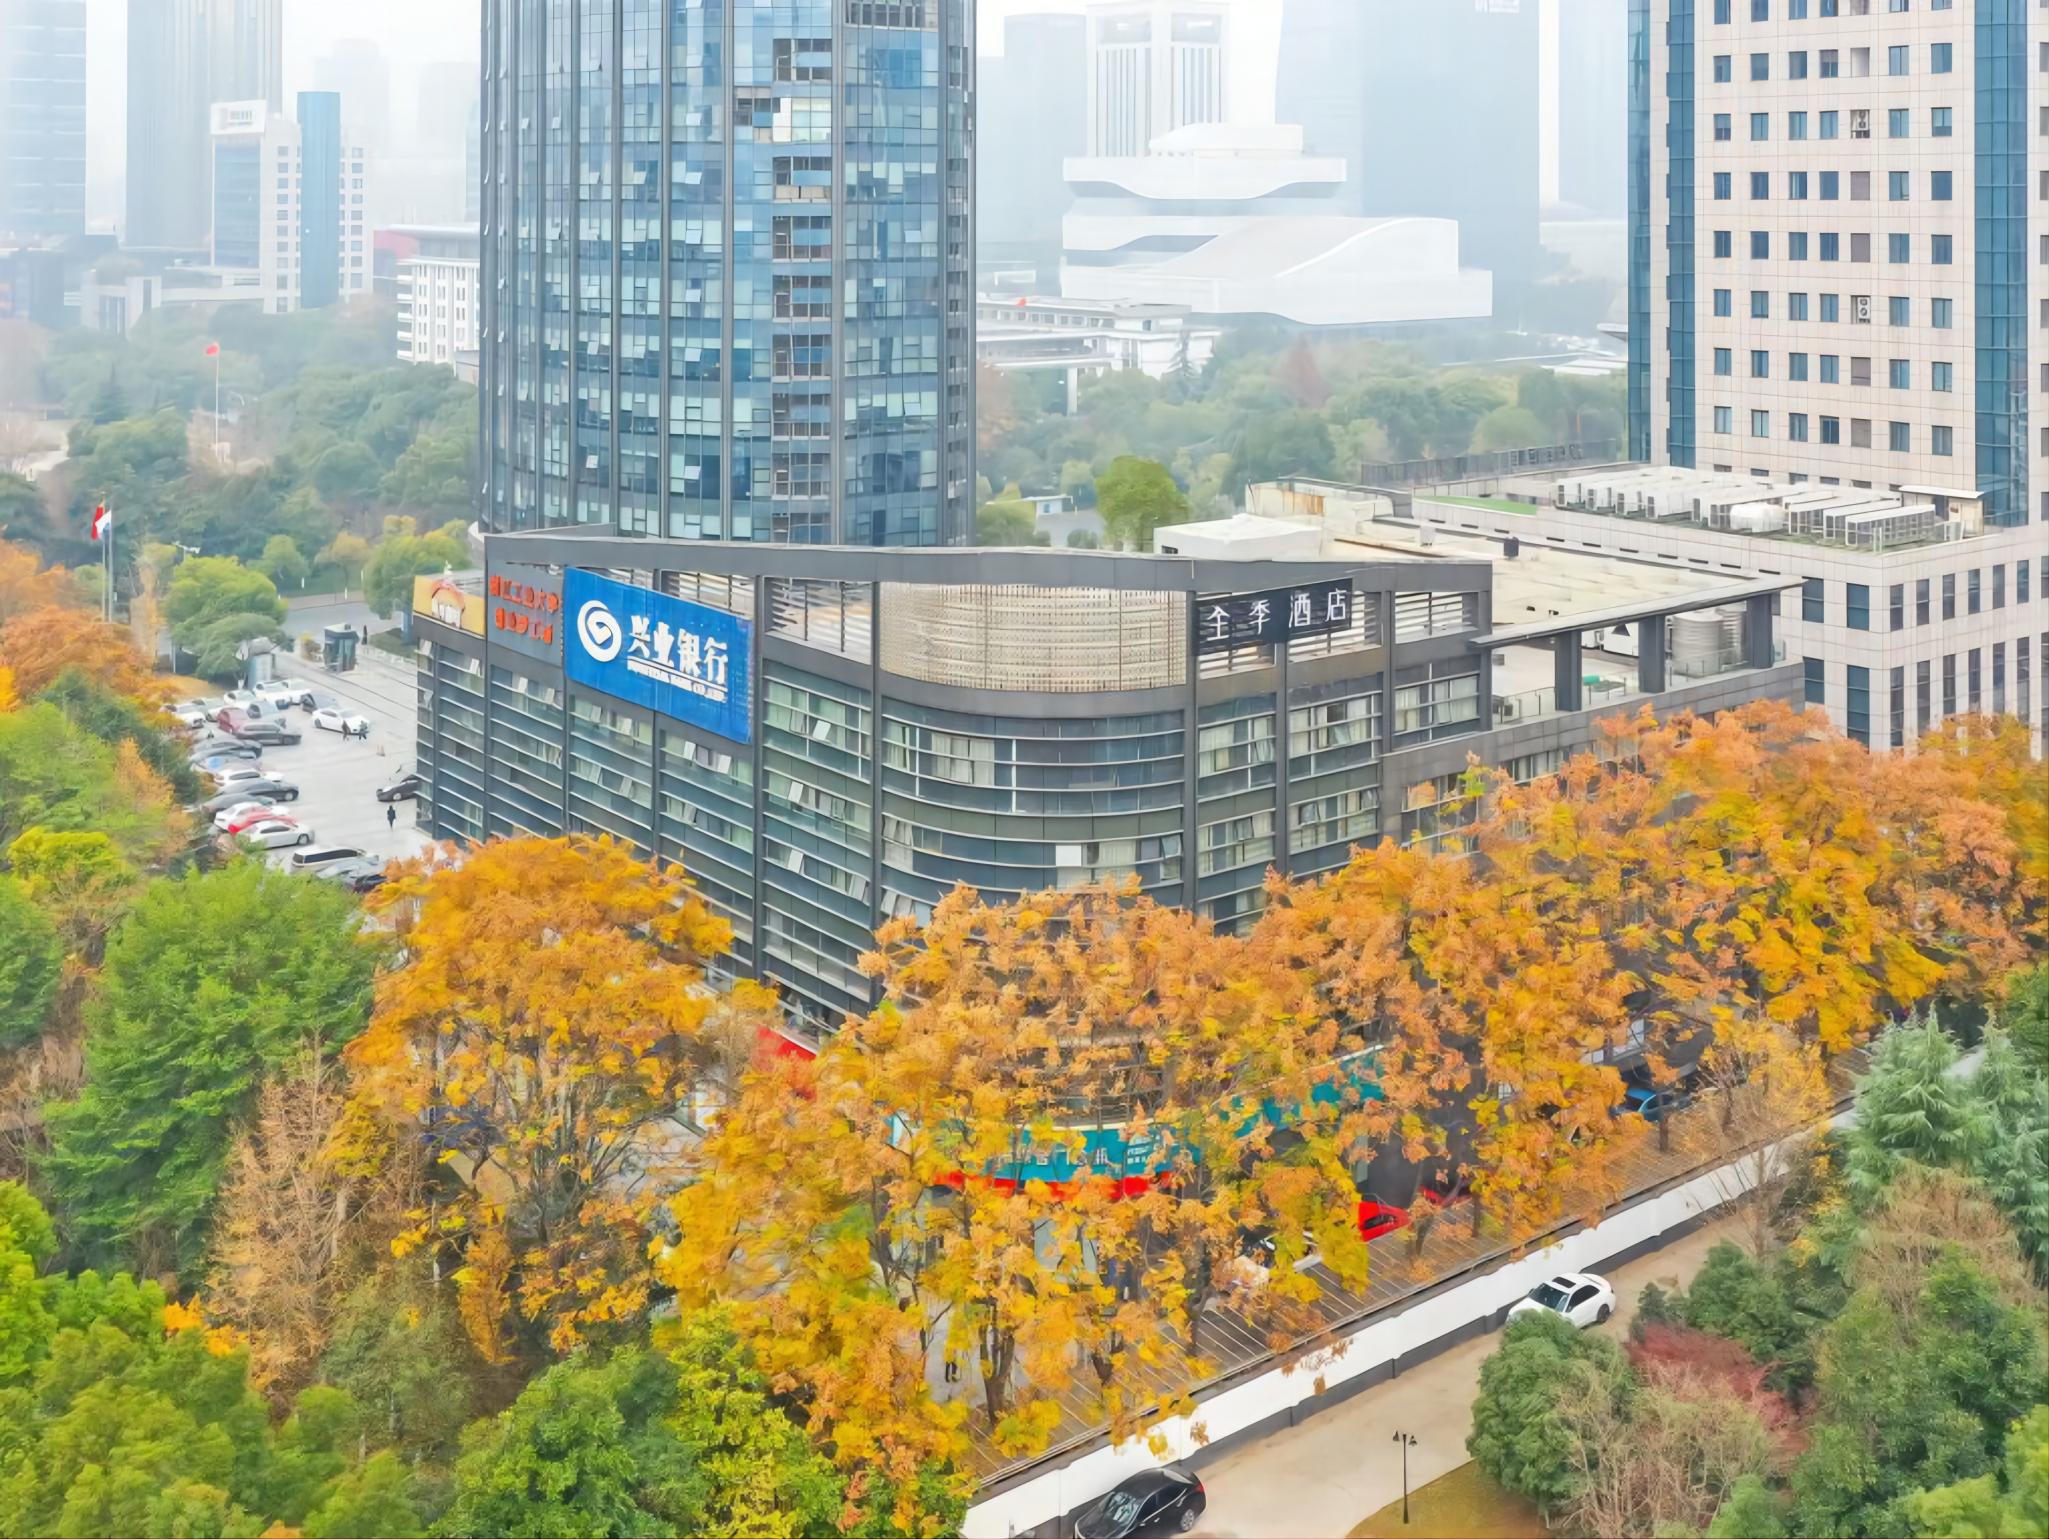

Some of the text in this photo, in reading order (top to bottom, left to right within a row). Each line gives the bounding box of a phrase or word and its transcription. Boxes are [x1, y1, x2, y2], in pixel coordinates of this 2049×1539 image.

[1206, 588, 1348, 642] 全季酒店
[627, 615, 729, 685] 兴业银行
